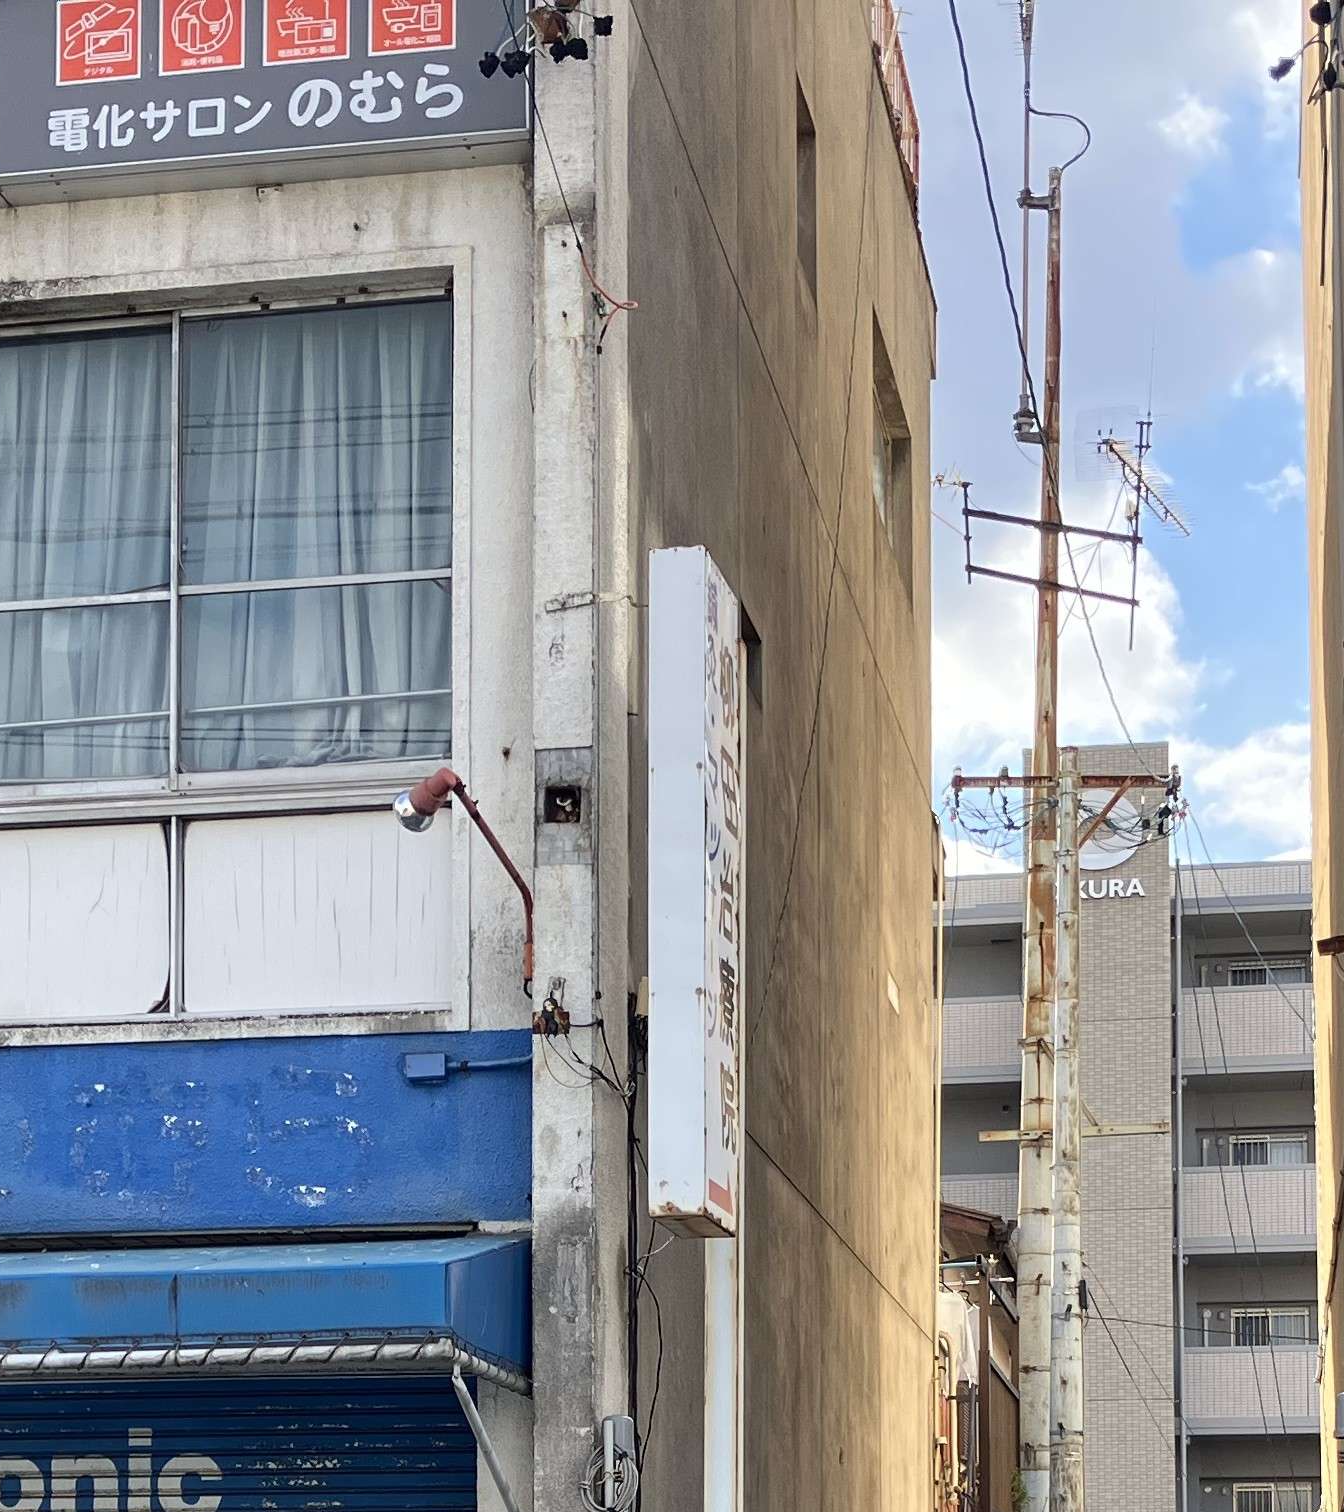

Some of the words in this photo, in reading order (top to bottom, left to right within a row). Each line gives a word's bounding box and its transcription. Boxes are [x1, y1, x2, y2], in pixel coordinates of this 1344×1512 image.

[46, 92, 273, 153] 電化サロン
[287, 62, 465, 128] のむら
